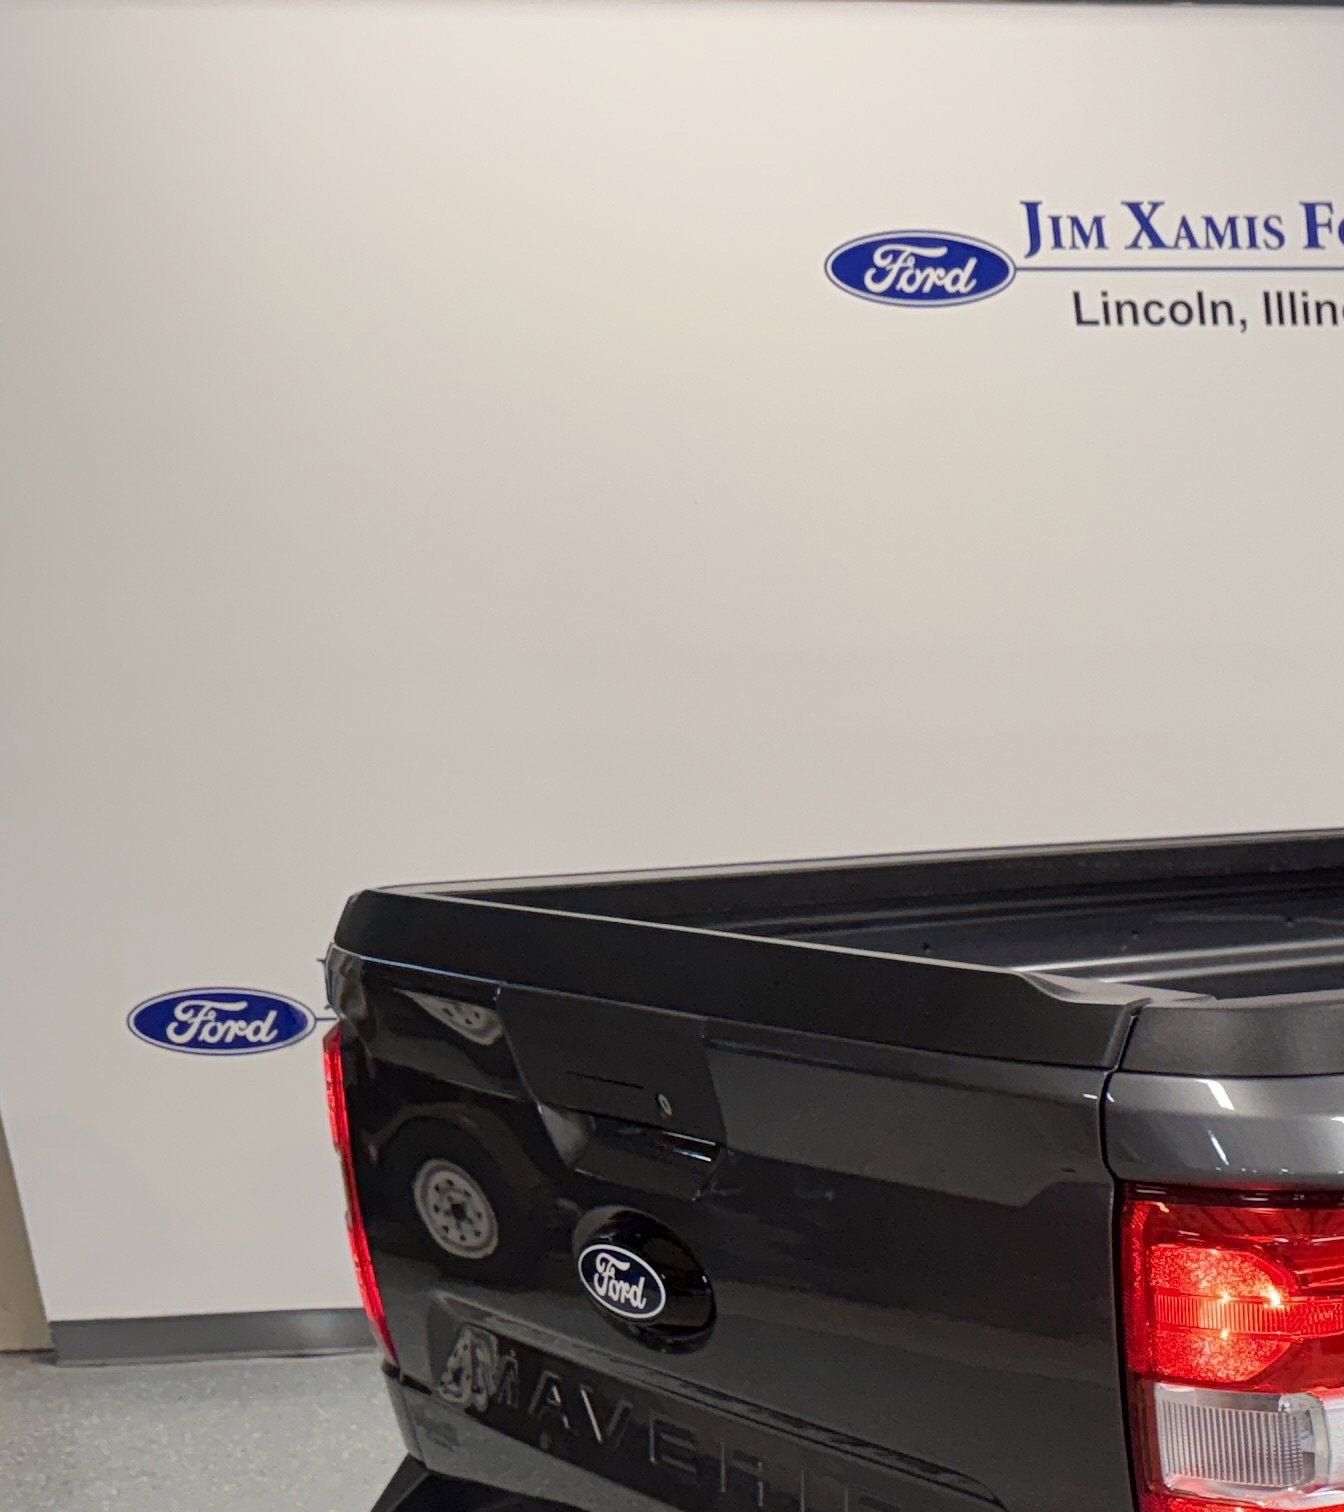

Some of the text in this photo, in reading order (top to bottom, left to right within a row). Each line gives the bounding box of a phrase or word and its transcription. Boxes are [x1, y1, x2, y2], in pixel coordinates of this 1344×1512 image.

[1019, 201, 1109, 259] JIM
[1121, 201, 1286, 251] XAMIS
[863, 244, 977, 295] Ford
[1073, 290, 1248, 333] Lincoln,
[165, 999, 279, 1044] Ford
[593, 1252, 647, 1309] Ford
